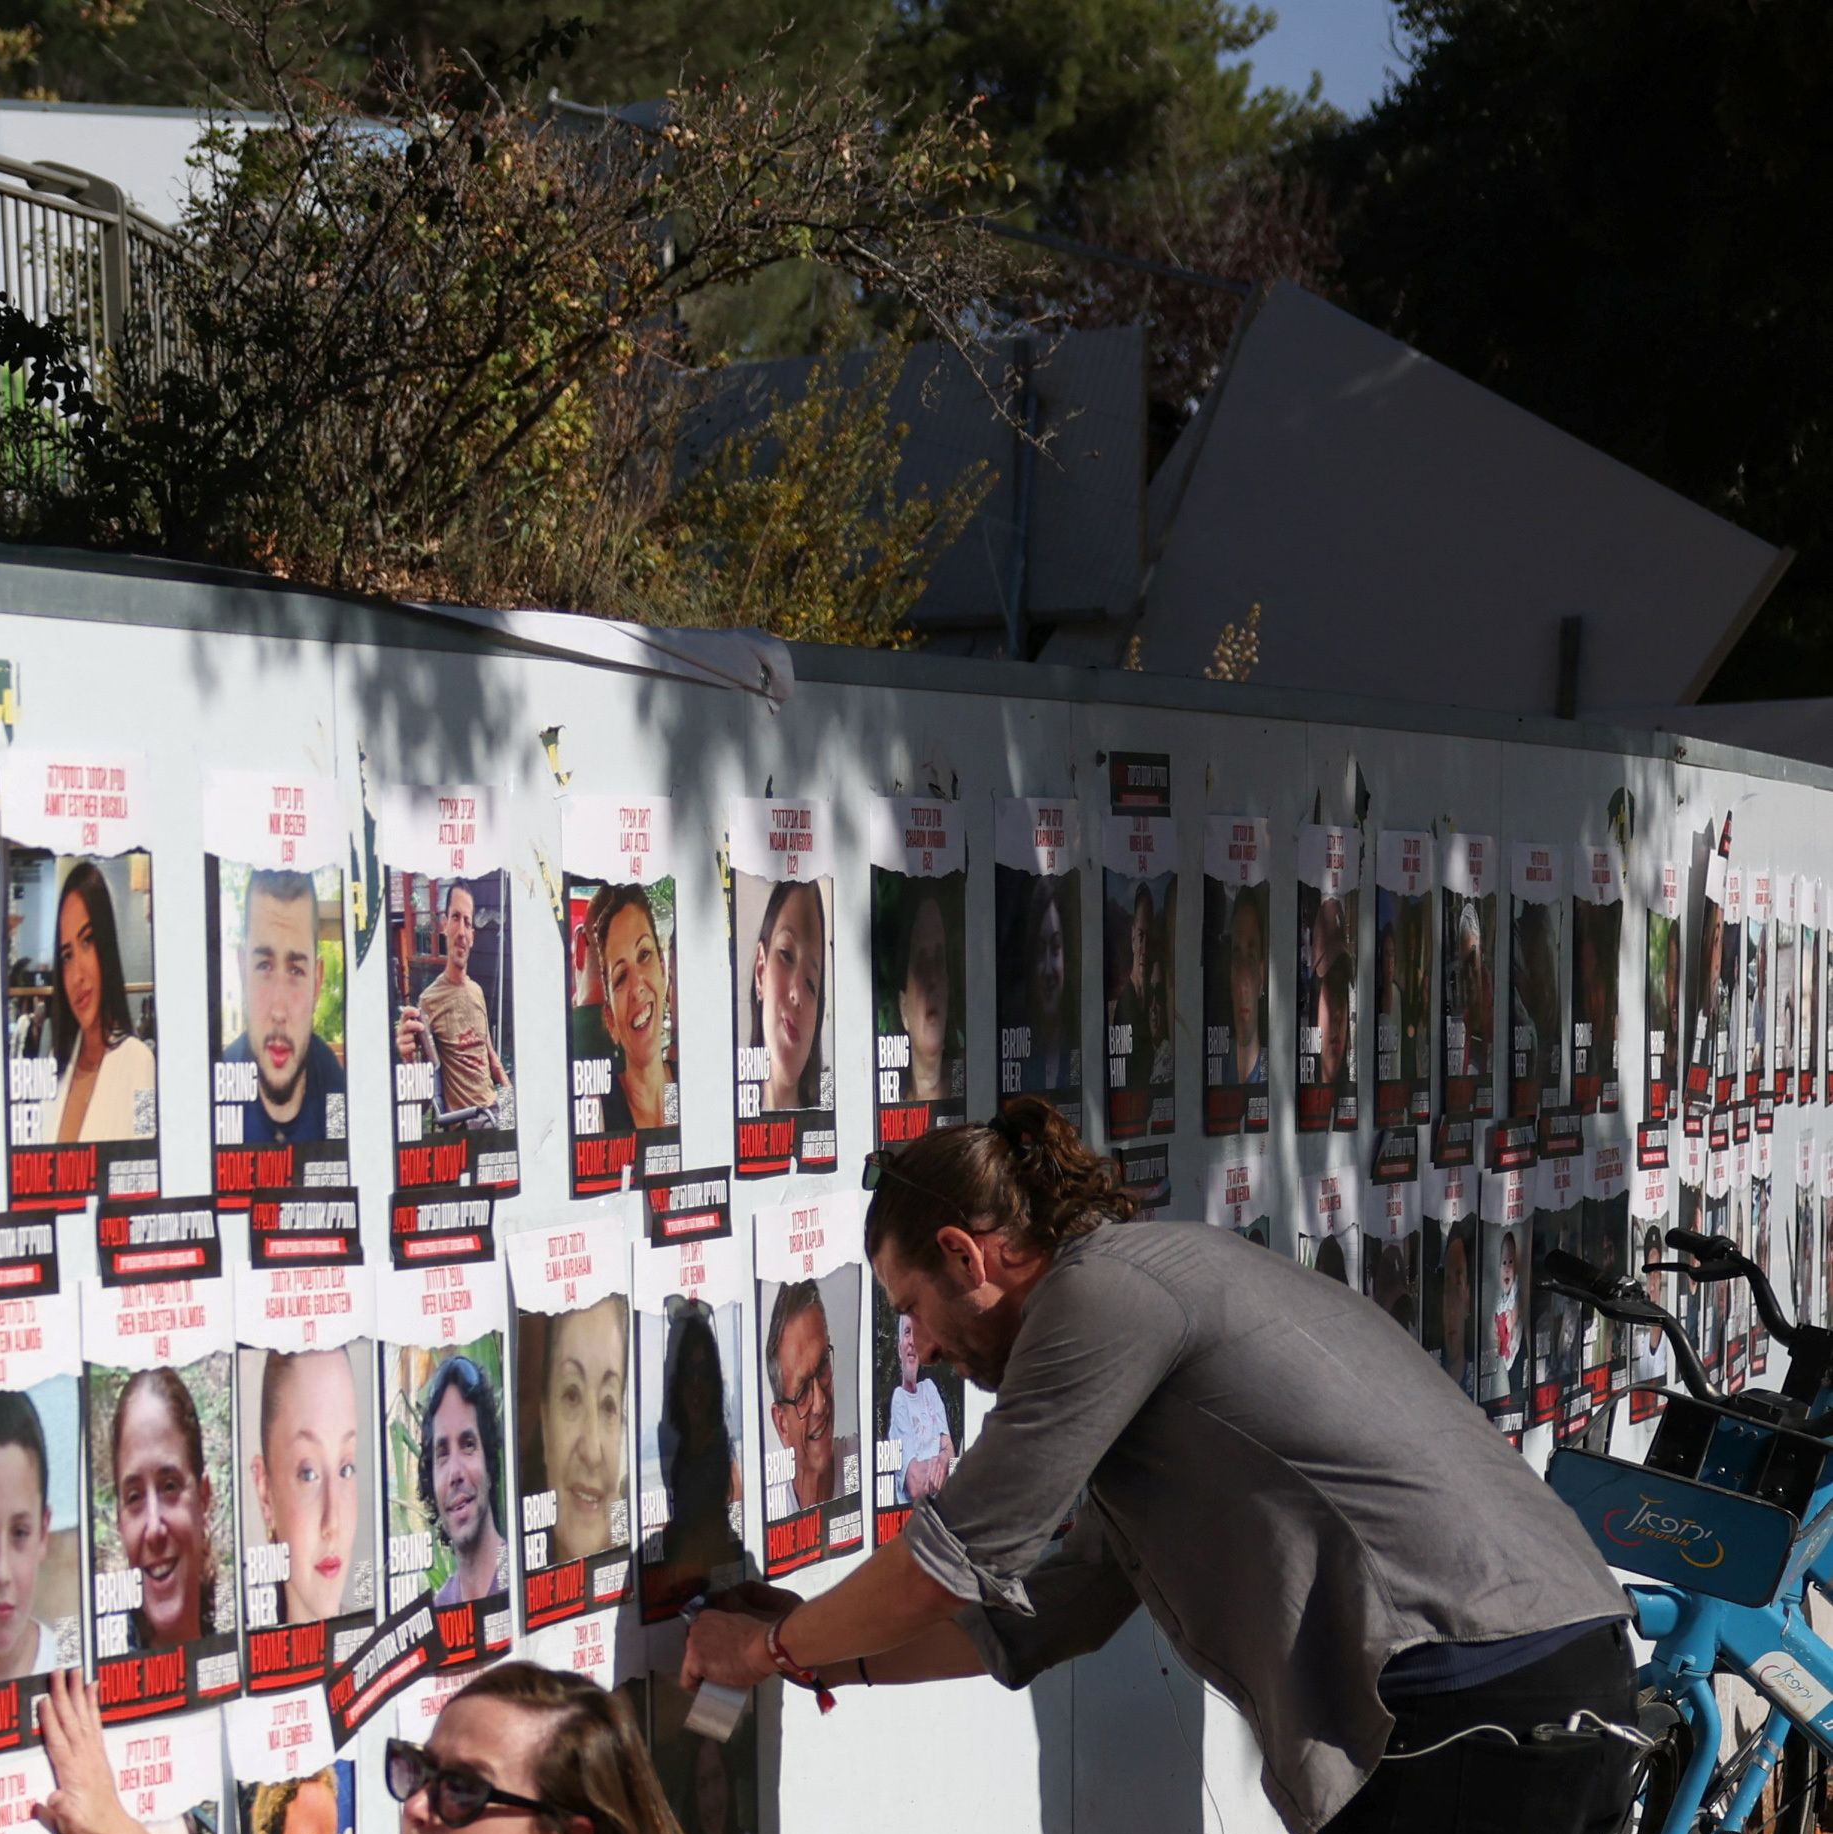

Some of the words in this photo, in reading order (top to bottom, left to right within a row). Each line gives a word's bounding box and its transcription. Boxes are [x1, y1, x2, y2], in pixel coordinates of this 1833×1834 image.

[439, 824, 459, 844] ATZILI
[621, 833, 633, 852] LIAT
[770, 832, 787, 852] NOAM
[787, 855, 798, 877] (12)
[738, 1047, 771, 1083] BRING
[879, 1035, 909, 1068] BRING
[11, 1057, 57, 1100] BRING
[396, 1062, 434, 1101] BRING
[574, 1060, 611, 1097] BRING
[880, 1071, 899, 1104] HER
[576, 1099, 602, 1135] HER
[739, 1085, 760, 1118] HER
[13, 1103, 42, 1144] HER
[397, 1103, 422, 1142] HIM
[739, 1122, 766, 1158] HOME
[768, 1118, 794, 1155] NOW!
[12, 1154, 54, 1193] HOME
[56, 1146, 97, 1192] NOW!
[399, 1147, 432, 1184] HOME
[434, 1139, 467, 1182] NOW!
[575, 1138, 606, 1176] HOME
[608, 1133, 636, 1172] NOW!
[790, 1234, 804, 1254] DROR
[545, 1260, 562, 1282] ELMA
[765, 1448, 796, 1486] BRING
[523, 1490, 557, 1532] BRING
[766, 1484, 788, 1520] HIM
[526, 1533, 547, 1570] HER
[95, 1568, 142, 1614] BRING
[97, 1615, 128, 1657] HER
[100, 1663, 141, 1703] HOME
[143, 1646, 185, 1696] NOW!
